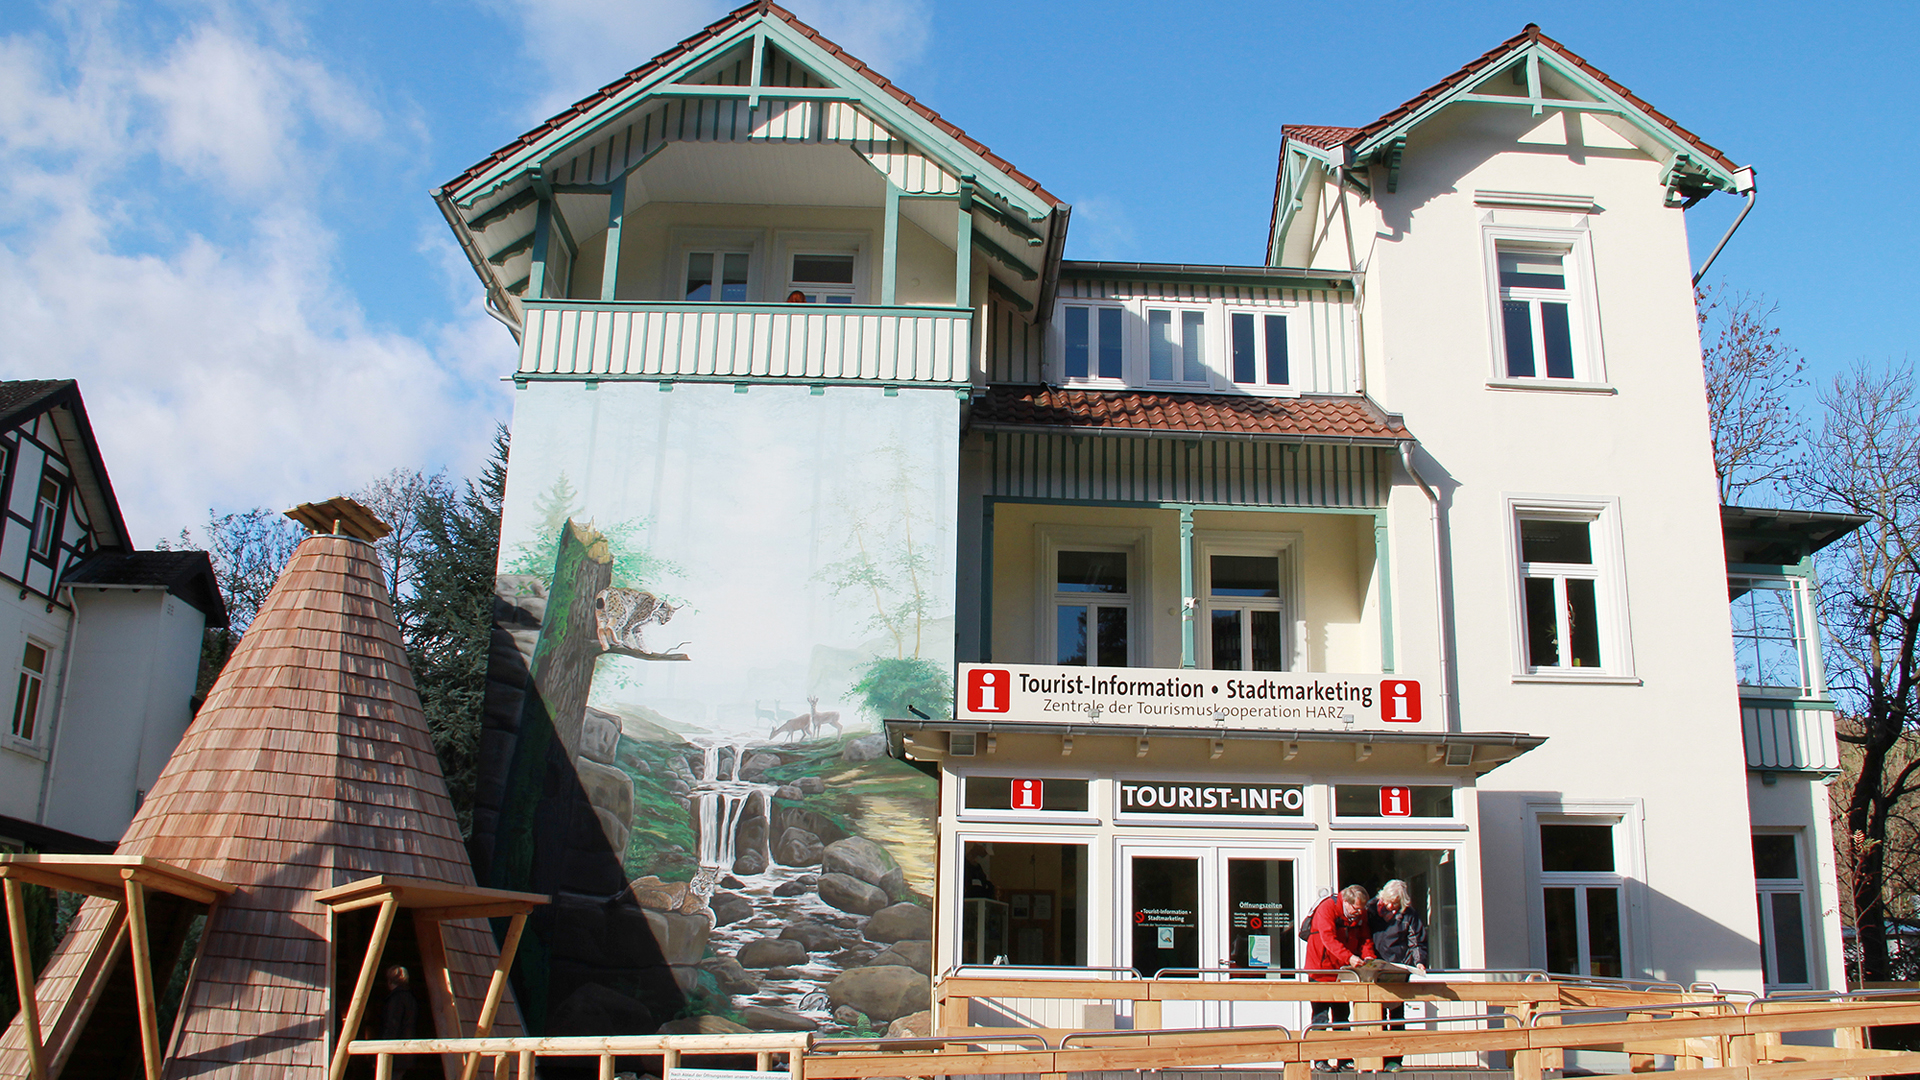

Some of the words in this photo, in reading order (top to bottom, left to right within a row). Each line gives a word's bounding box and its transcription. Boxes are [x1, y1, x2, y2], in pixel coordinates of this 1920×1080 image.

[1019, 673, 1204, 699] Tourist-Information
[1226, 679, 1373, 708] Stadtmarketing
[1043, 699, 1104, 713] Zentrale
[1108, 701, 1133, 714] der
[1137, 701, 1301, 722] Tourismuskooperation
[1305, 705, 1345, 719] HARZ
[1122, 785, 1304, 810] TOURIST-INFO
[1143, 908, 1189, 916] Tourist-Information
[1239, 901, 1283, 910] Öffnungszeiten
[1147, 915, 1185, 923] Stadtmarketing
